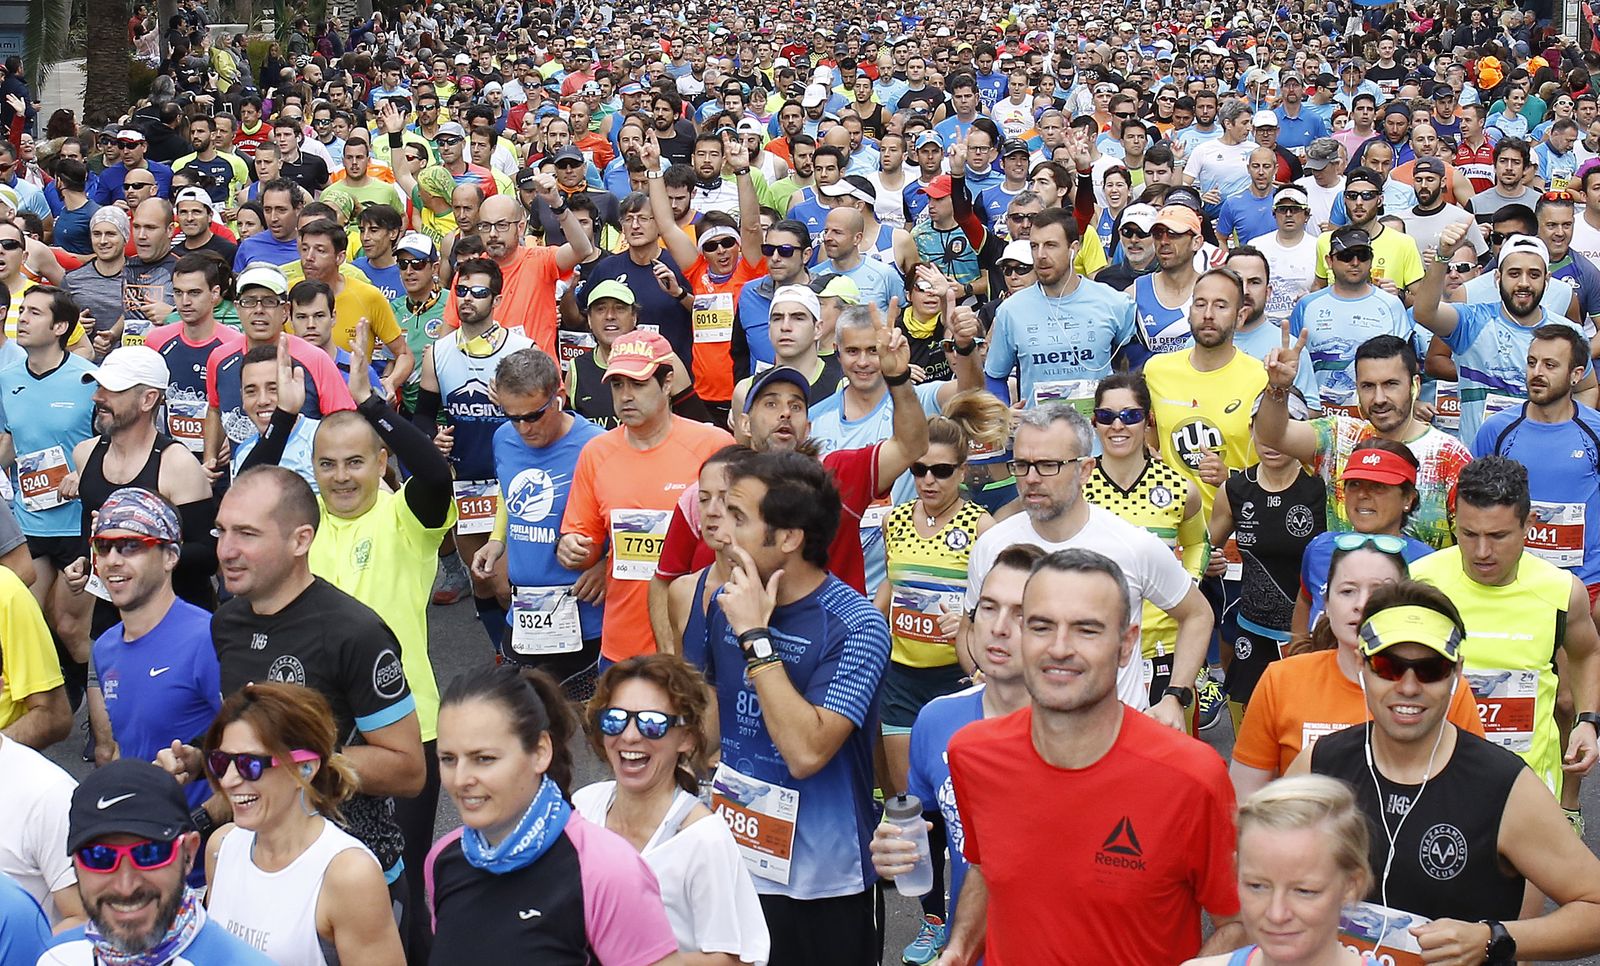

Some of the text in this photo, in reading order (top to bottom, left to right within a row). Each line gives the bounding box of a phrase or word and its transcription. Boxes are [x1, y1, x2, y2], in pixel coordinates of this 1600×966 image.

[696, 313, 718, 326] 6018
[1032, 346, 1095, 366] nerja
[924, 359, 950, 375] ORK
[172, 419, 203, 434] 5103
[23, 473, 50, 492] 5240
[461, 499, 492, 514] 5113
[529, 526, 556, 544] UMA
[1524, 526, 1557, 543] 041
[623, 536, 664, 555] 7797
[519, 613, 553, 630] 9324
[895, 611, 934, 635] 4919
[736, 714, 761, 728] TARIFA
[738, 726, 758, 739] 2017
[1420, 825, 1466, 861] TRAZACAMINOS
[1095, 851, 1147, 871] Reebok
[1428, 864, 1456, 878] CLUB
[227, 919, 271, 952] BREATHE
